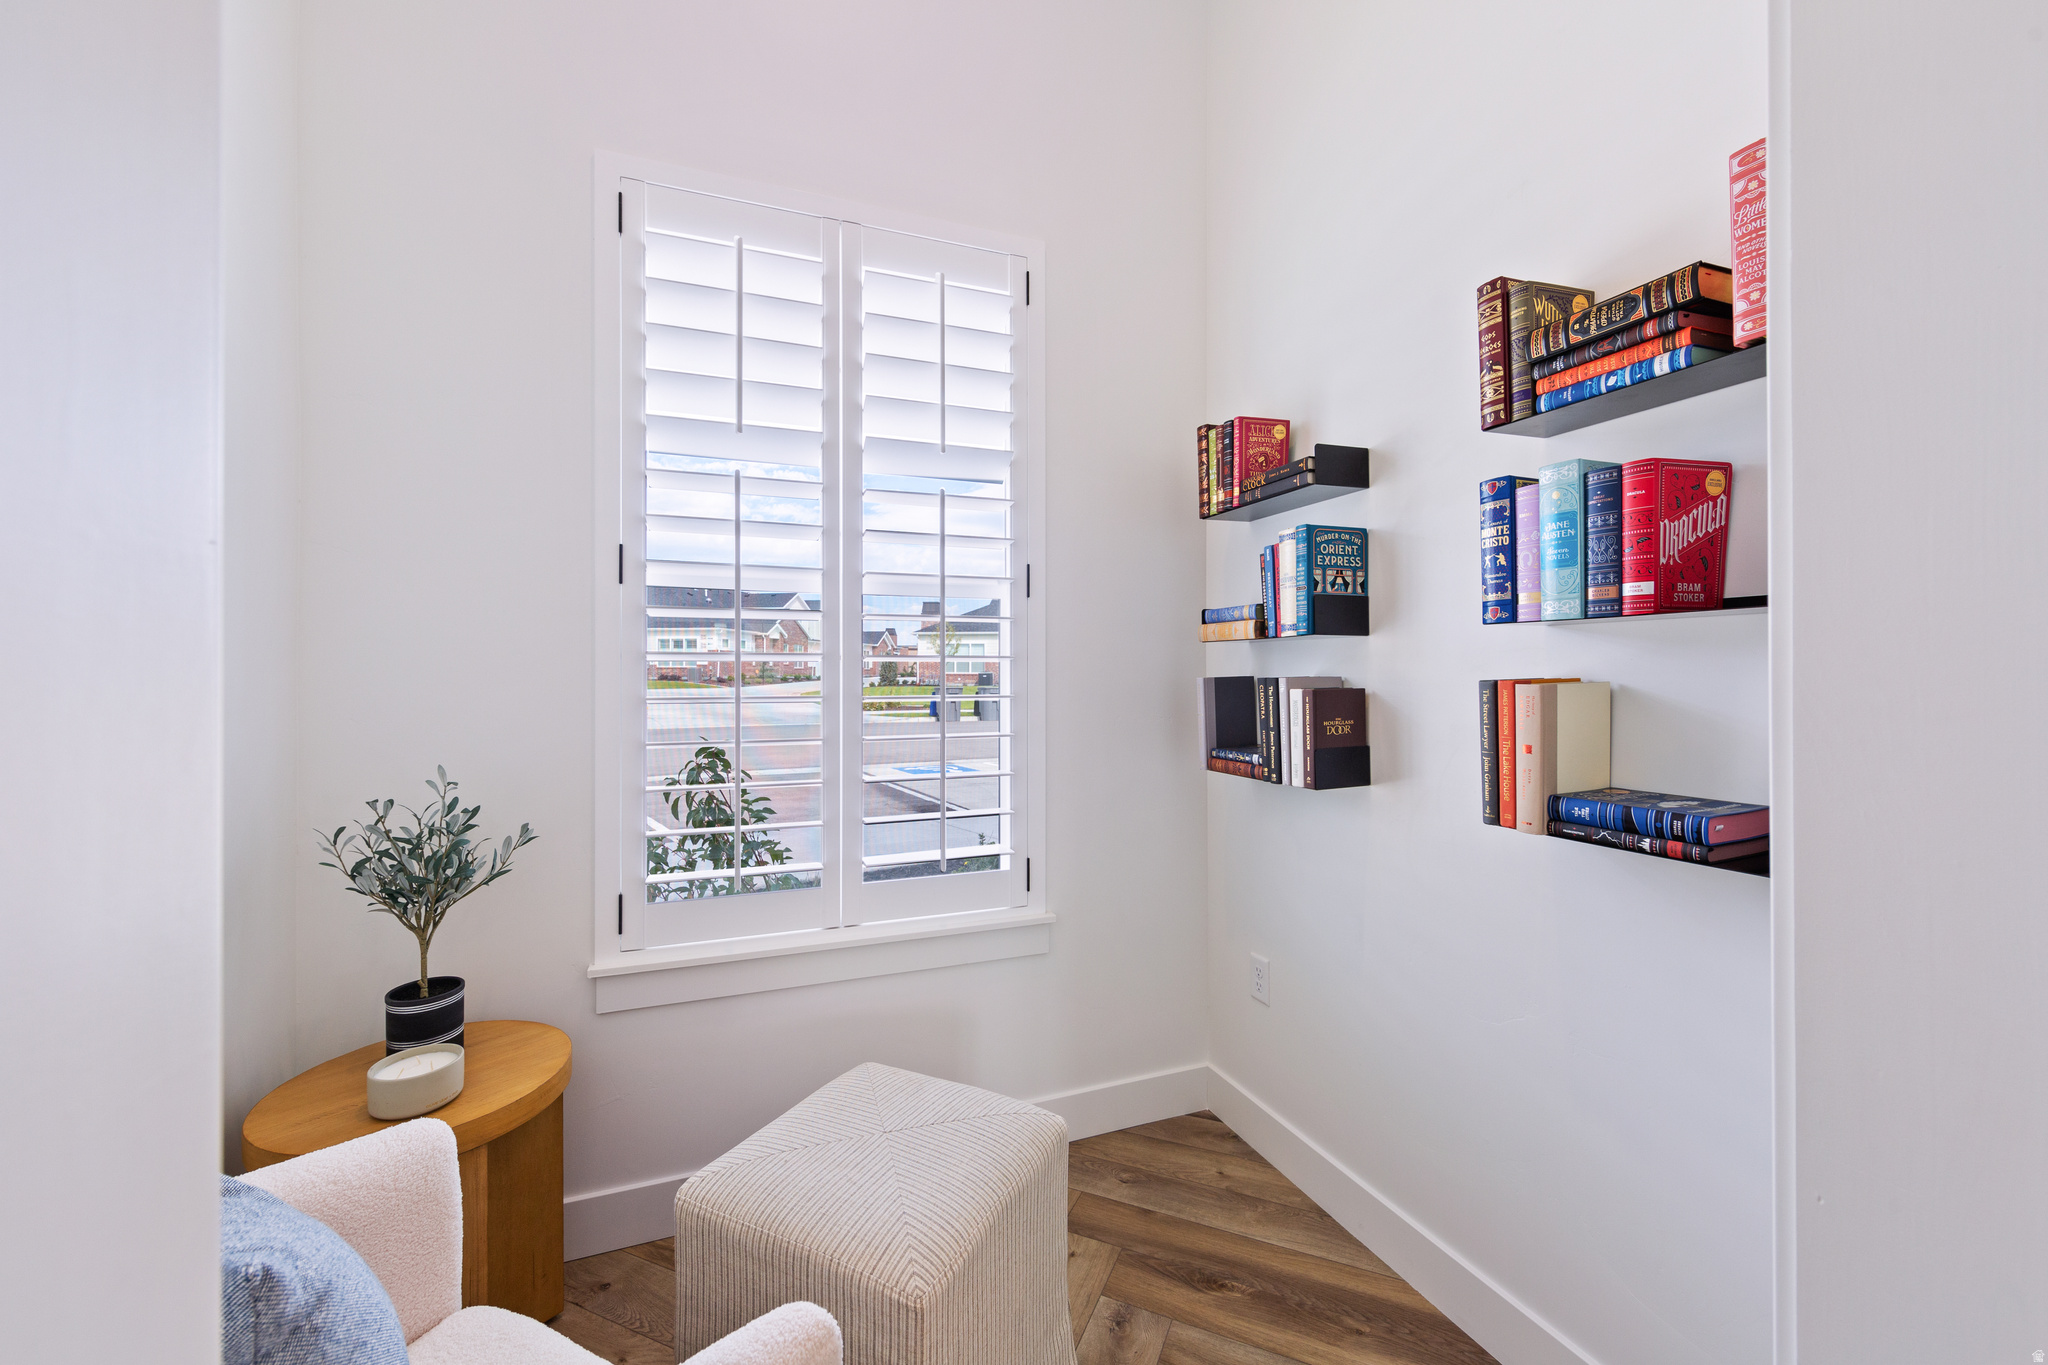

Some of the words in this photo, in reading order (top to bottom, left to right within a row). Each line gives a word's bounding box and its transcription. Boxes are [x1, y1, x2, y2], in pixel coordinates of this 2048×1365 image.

[1734, 217, 1767, 238] WOME
[1751, 236, 1767, 247] OTH
[1738, 255, 1766, 272] LOUIS
[1745, 263, 1765, 275] MAY
[1738, 269, 1767, 285] ALCOT
[1600, 305, 1608, 327] OPERA
[1481, 330, 1497, 343] GODS
[1247, 424, 1276, 438] ALICE
[1242, 478, 1267, 492] CLOCK
[1481, 524, 1510, 539] MONTE
[1544, 520, 1570, 533] JANE
[1659, 493, 1727, 566] DRACULA
[1316, 532, 1339, 543] MURDER
[1340, 533, 1350, 541] ON
[1351, 536, 1362, 546] THE
[1481, 535, 1510, 549] CRISTO
[1541, 528, 1576, 542] AUSTEN
[1320, 543, 1359, 556] ORIENT
[1317, 554, 1362, 567] EXPRESS
[1676, 582, 1701, 592] BRAM
[1673, 592, 1705, 602] STOKER
[1326, 725, 1352, 736] DOOR
[1502, 740, 1510, 756] The
[1503, 756, 1511, 774] Lake
[1504, 776, 1512, 802] House
